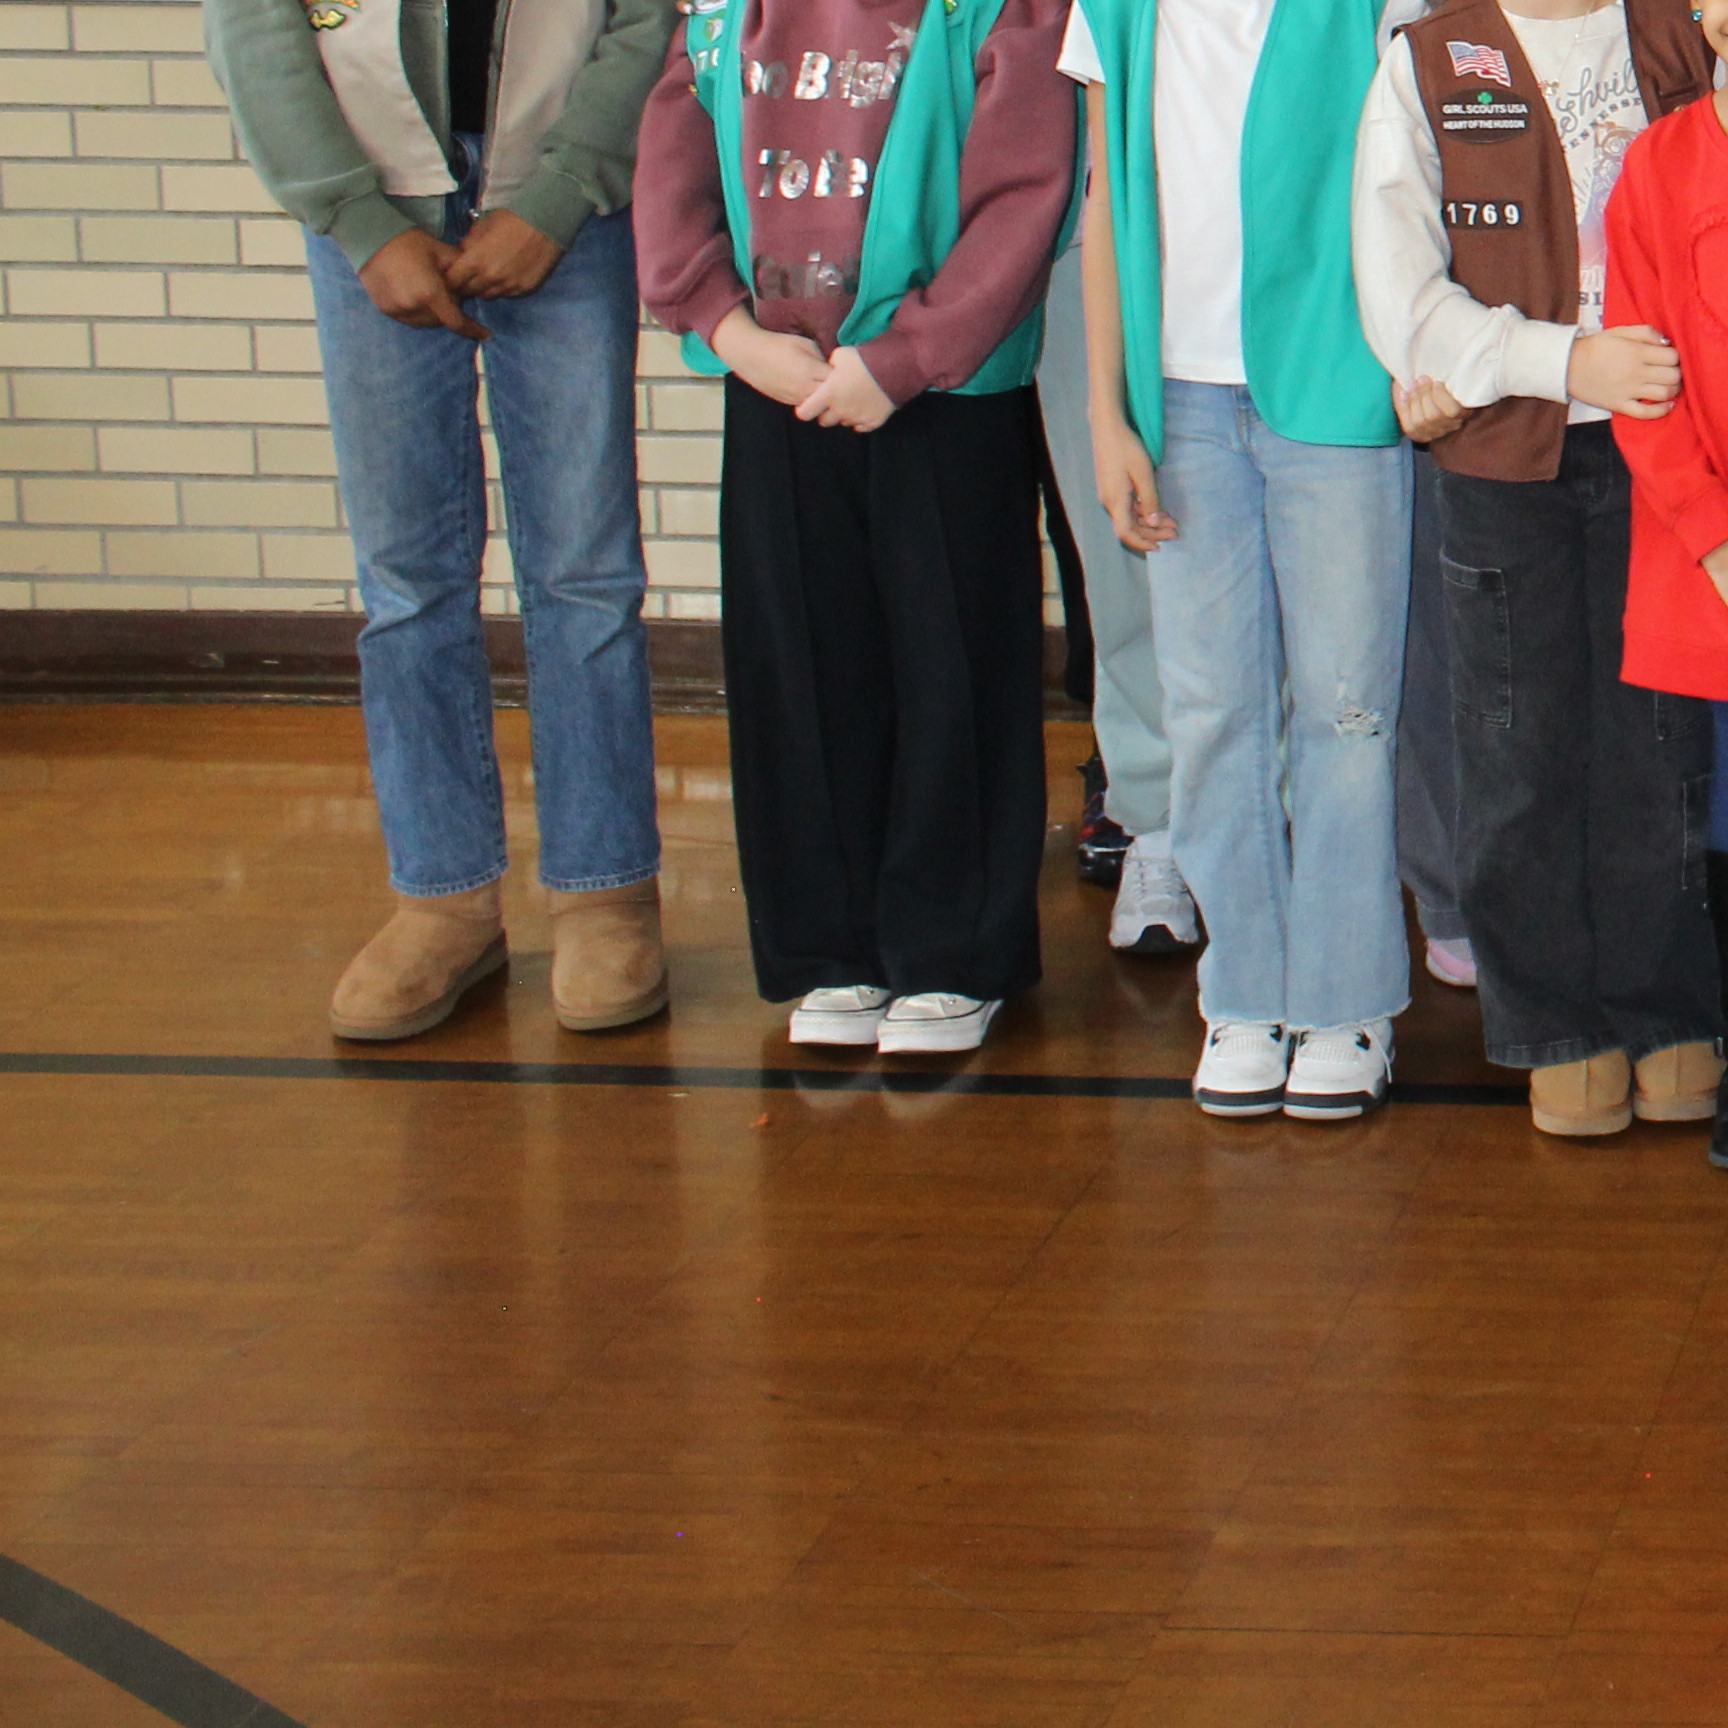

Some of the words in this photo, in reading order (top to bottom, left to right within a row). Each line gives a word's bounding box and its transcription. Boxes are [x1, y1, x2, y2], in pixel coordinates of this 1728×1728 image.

[1465, 103, 1506, 114] SCOUTS
[1507, 103, 1529, 114] USA
[758, 149, 810, 200] To
[1446, 203, 1521, 225] 1769
